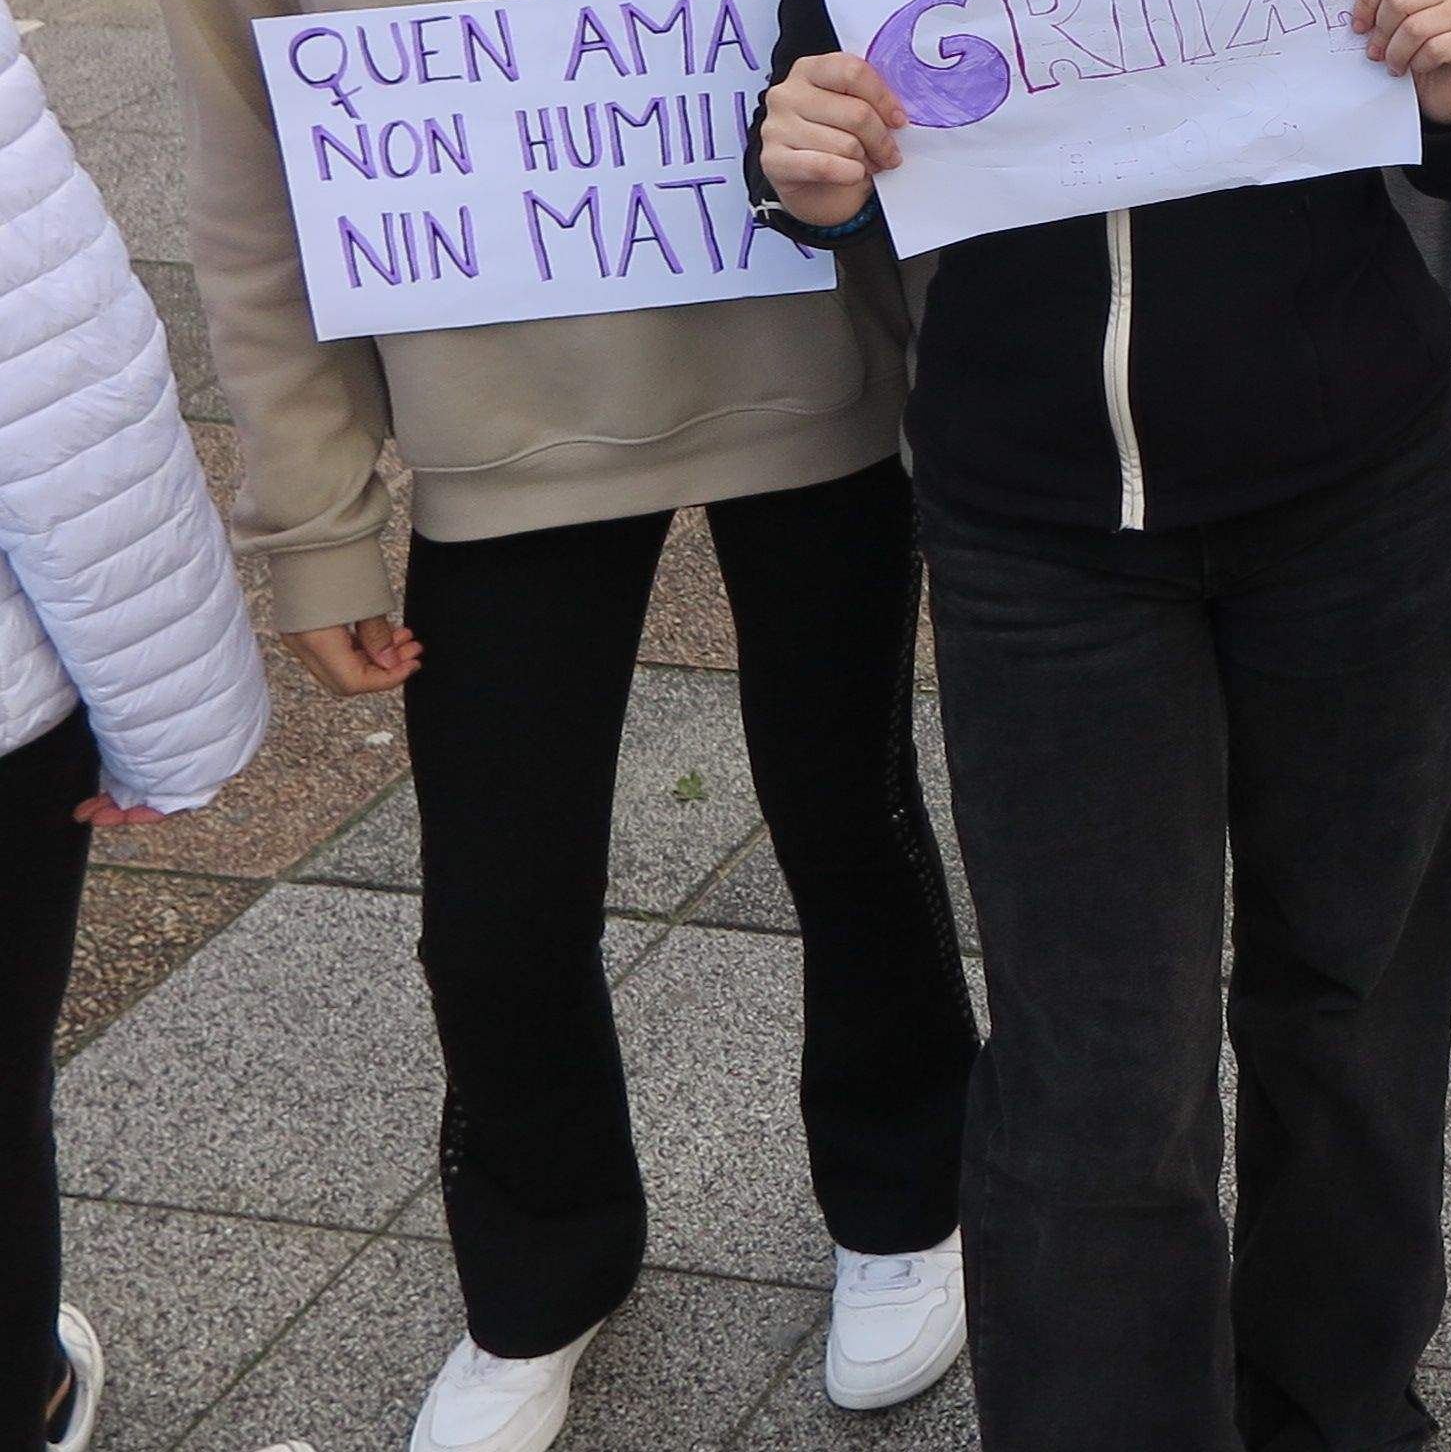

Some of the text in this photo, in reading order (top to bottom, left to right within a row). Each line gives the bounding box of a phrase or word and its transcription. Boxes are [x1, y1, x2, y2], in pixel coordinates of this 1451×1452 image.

[288, 9, 518, 118] QUEN
[312, 114, 474, 182] NON
[338, 205, 480, 288] NIN
